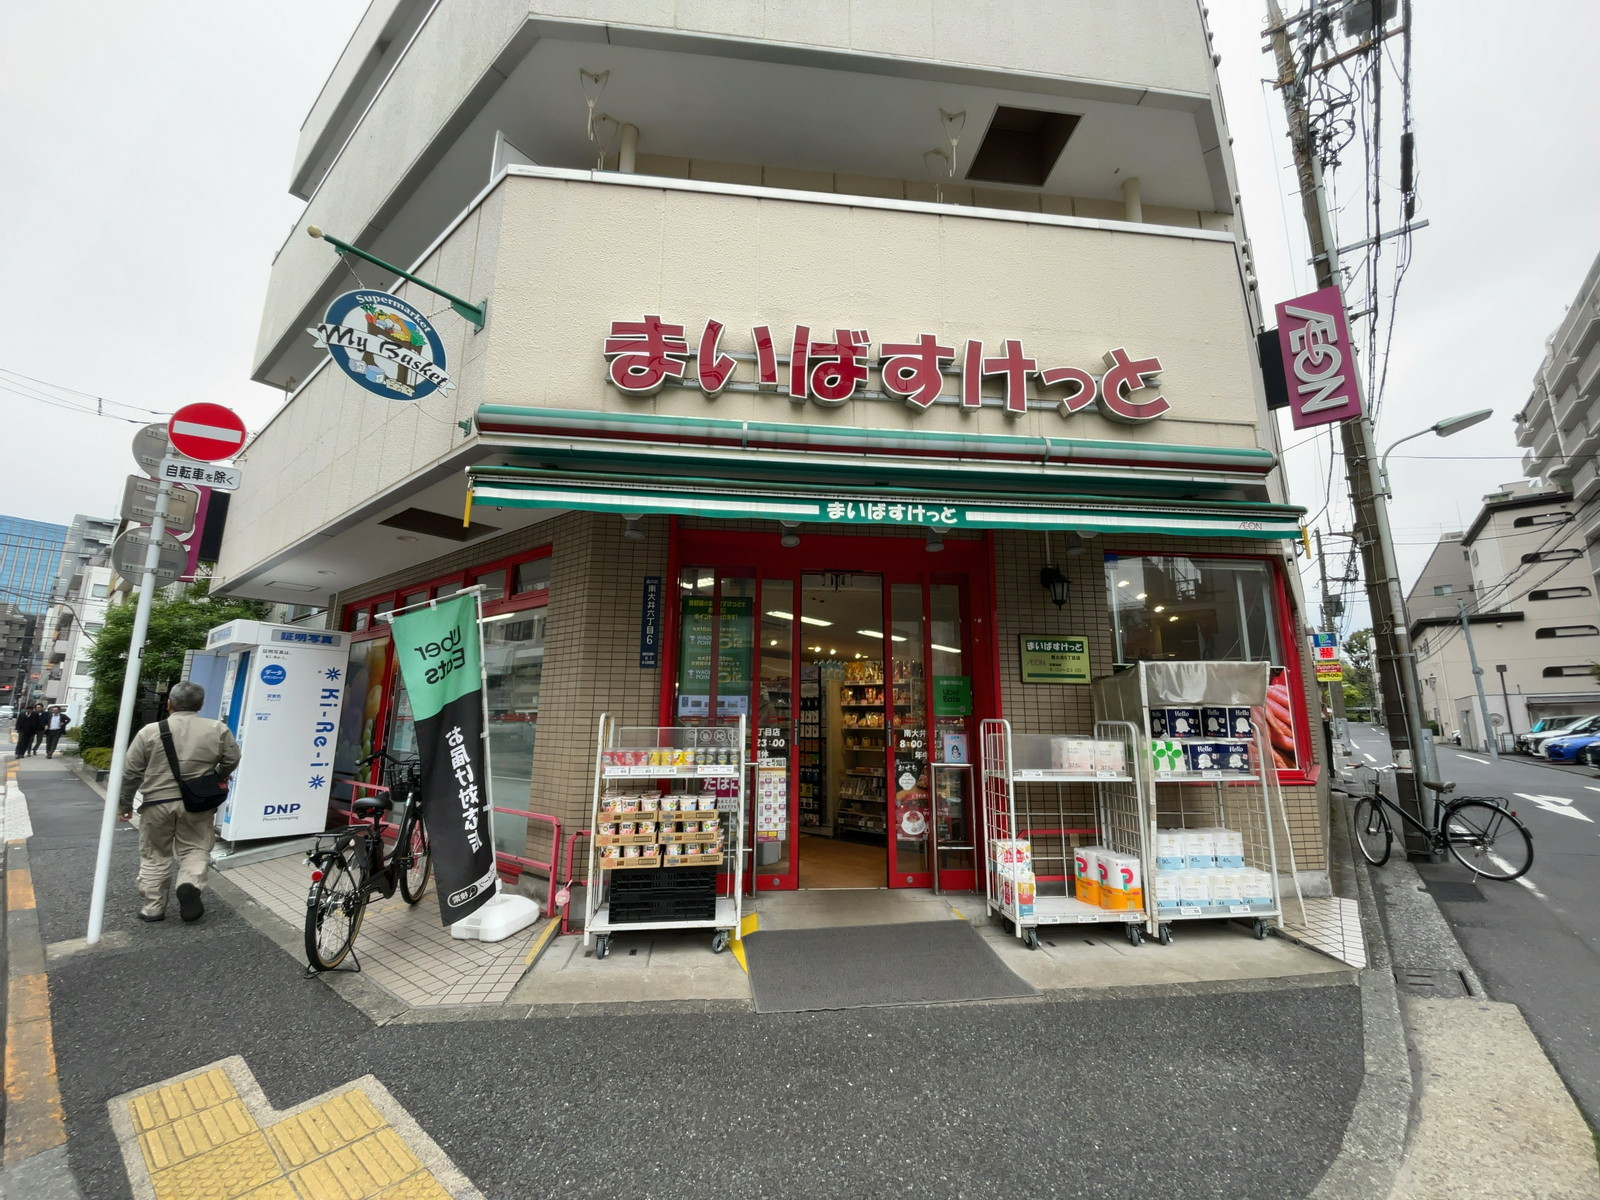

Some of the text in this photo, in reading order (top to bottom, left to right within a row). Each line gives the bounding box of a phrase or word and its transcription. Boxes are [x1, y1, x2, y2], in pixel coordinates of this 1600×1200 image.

[356, 294, 431, 333] Supermarket
[317, 324, 448, 387] My Basket
[604, 315, 1171, 422] まいばすけっと
[1284, 304, 1349, 414] AEON
[166, 464, 234, 485] 自転車を除く
[827, 502, 958, 524] まいばすけっと
[280, 631, 334, 645] 証明写真
[1027, 641, 1083, 652] まいばすけっと
[310, 688, 340, 767] Ki-Re-i
[263, 803, 301, 816] DNP
